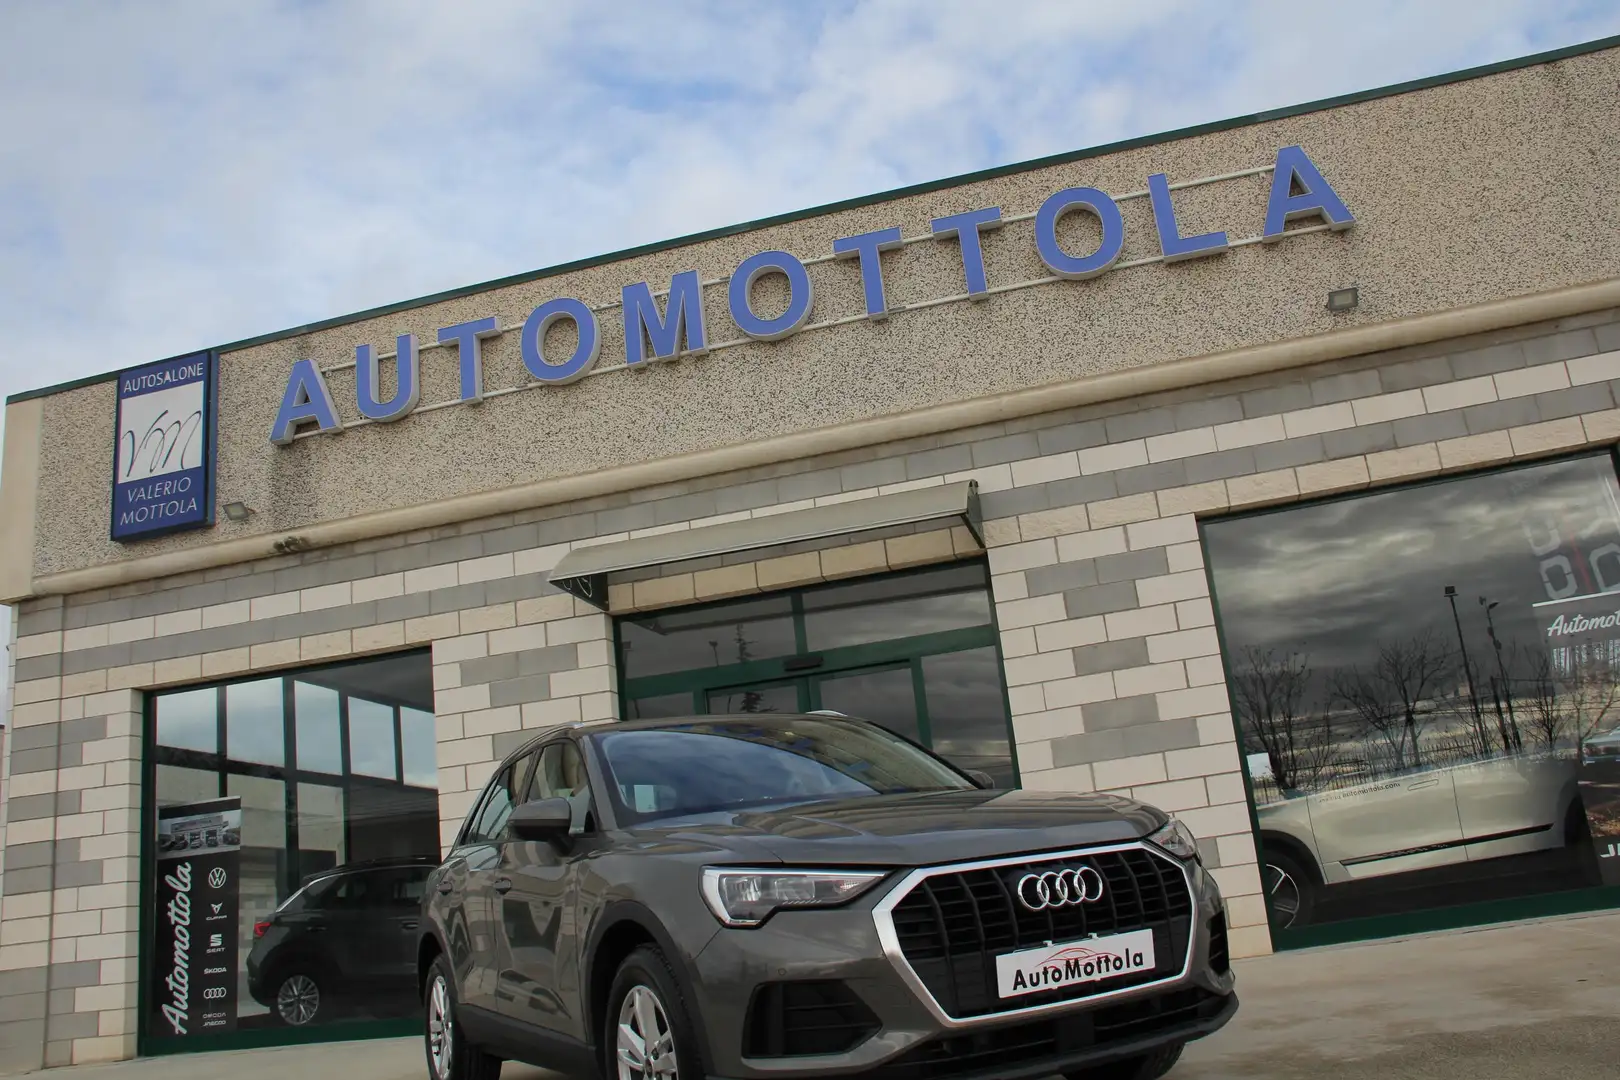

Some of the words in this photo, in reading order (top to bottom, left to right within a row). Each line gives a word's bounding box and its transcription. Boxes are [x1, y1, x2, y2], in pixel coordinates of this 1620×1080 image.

[270, 145, 1355, 445] AUTOMOTTOLA
[123, 362, 204, 394] AUTOSALONE
[127, 476, 192, 503] VALERIO
[120, 498, 198, 526] MOTTOLA
[162, 861, 192, 1035] Automottola
[1012, 948, 1144, 991] AutoMottola
